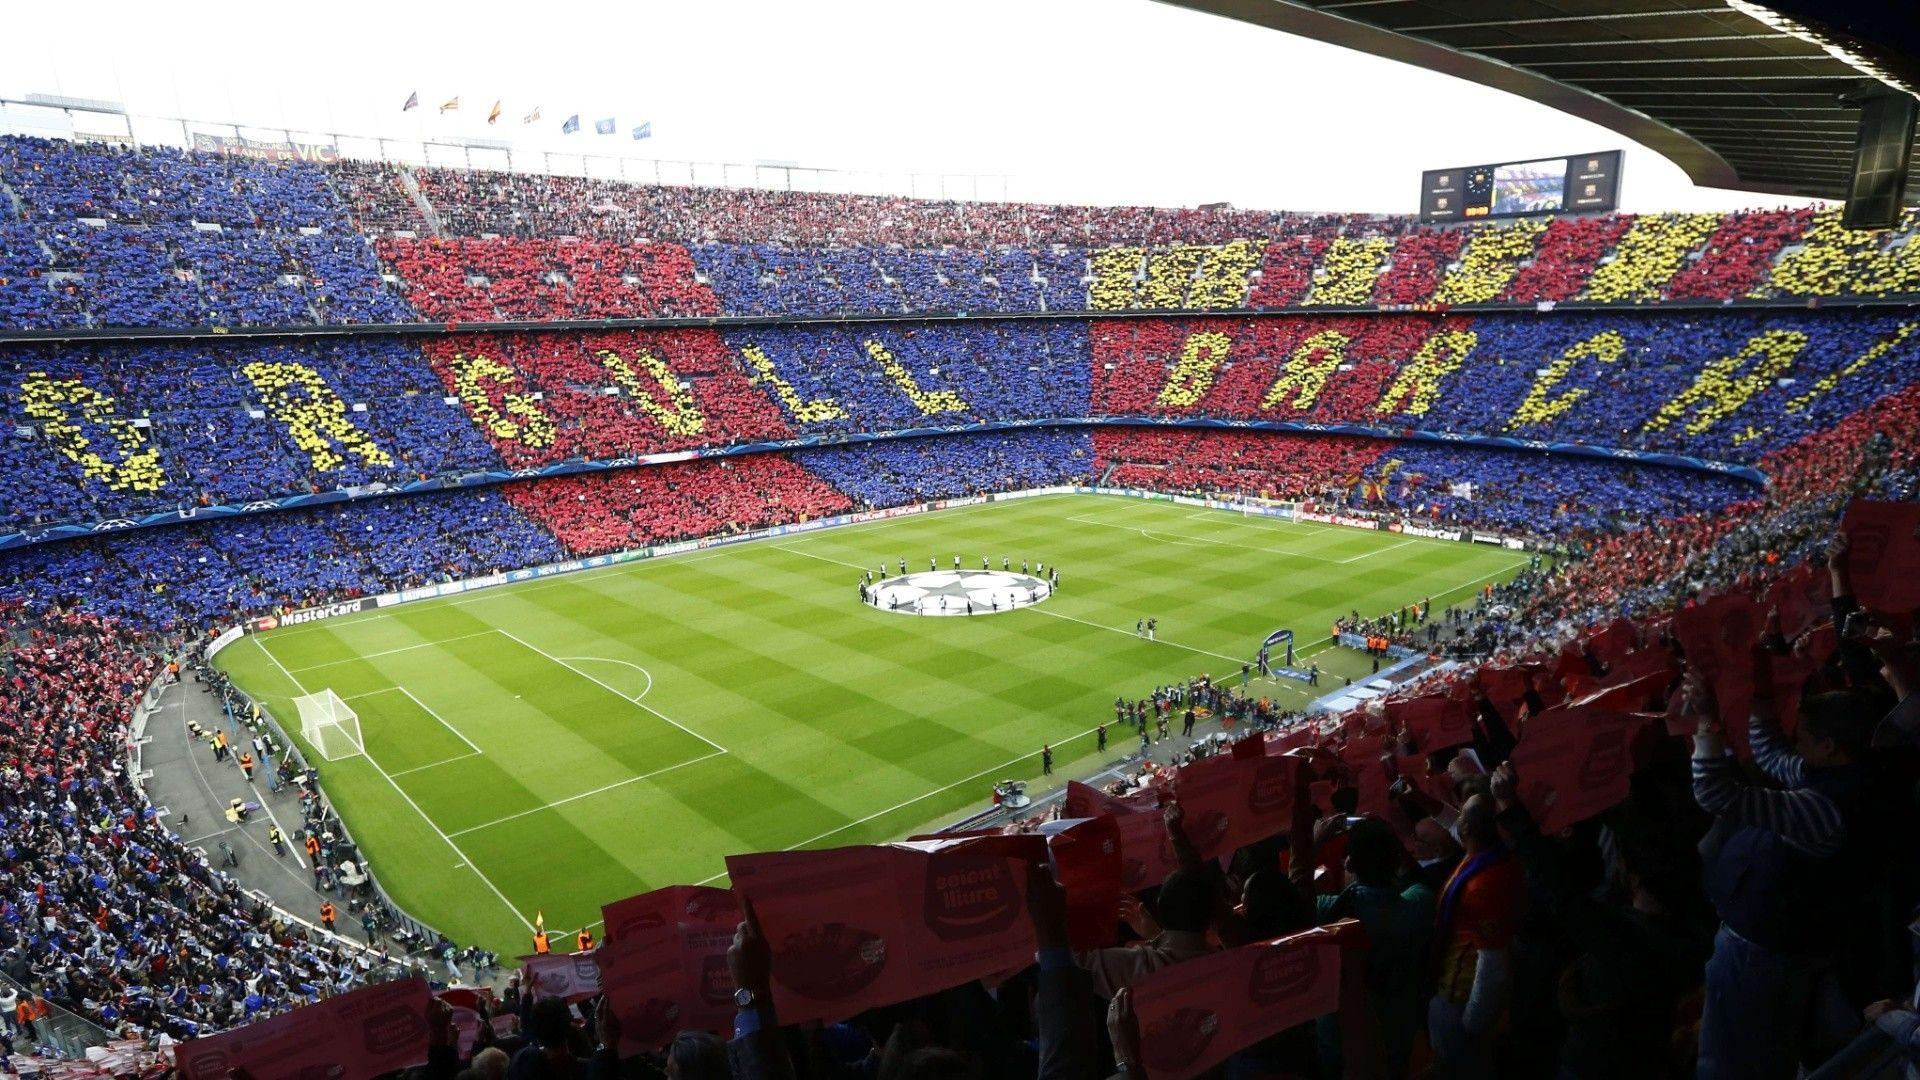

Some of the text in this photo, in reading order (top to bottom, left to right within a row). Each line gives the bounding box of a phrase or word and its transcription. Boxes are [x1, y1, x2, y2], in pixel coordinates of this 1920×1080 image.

[295, 143, 332, 163] VIC
[1403, 525, 1461, 541] MasterCard
[653, 541, 698, 556] Heineken
[538, 566, 557, 576] NEW
[559, 562, 583, 572] KUGA
[281, 601, 361, 627] MasterCard
